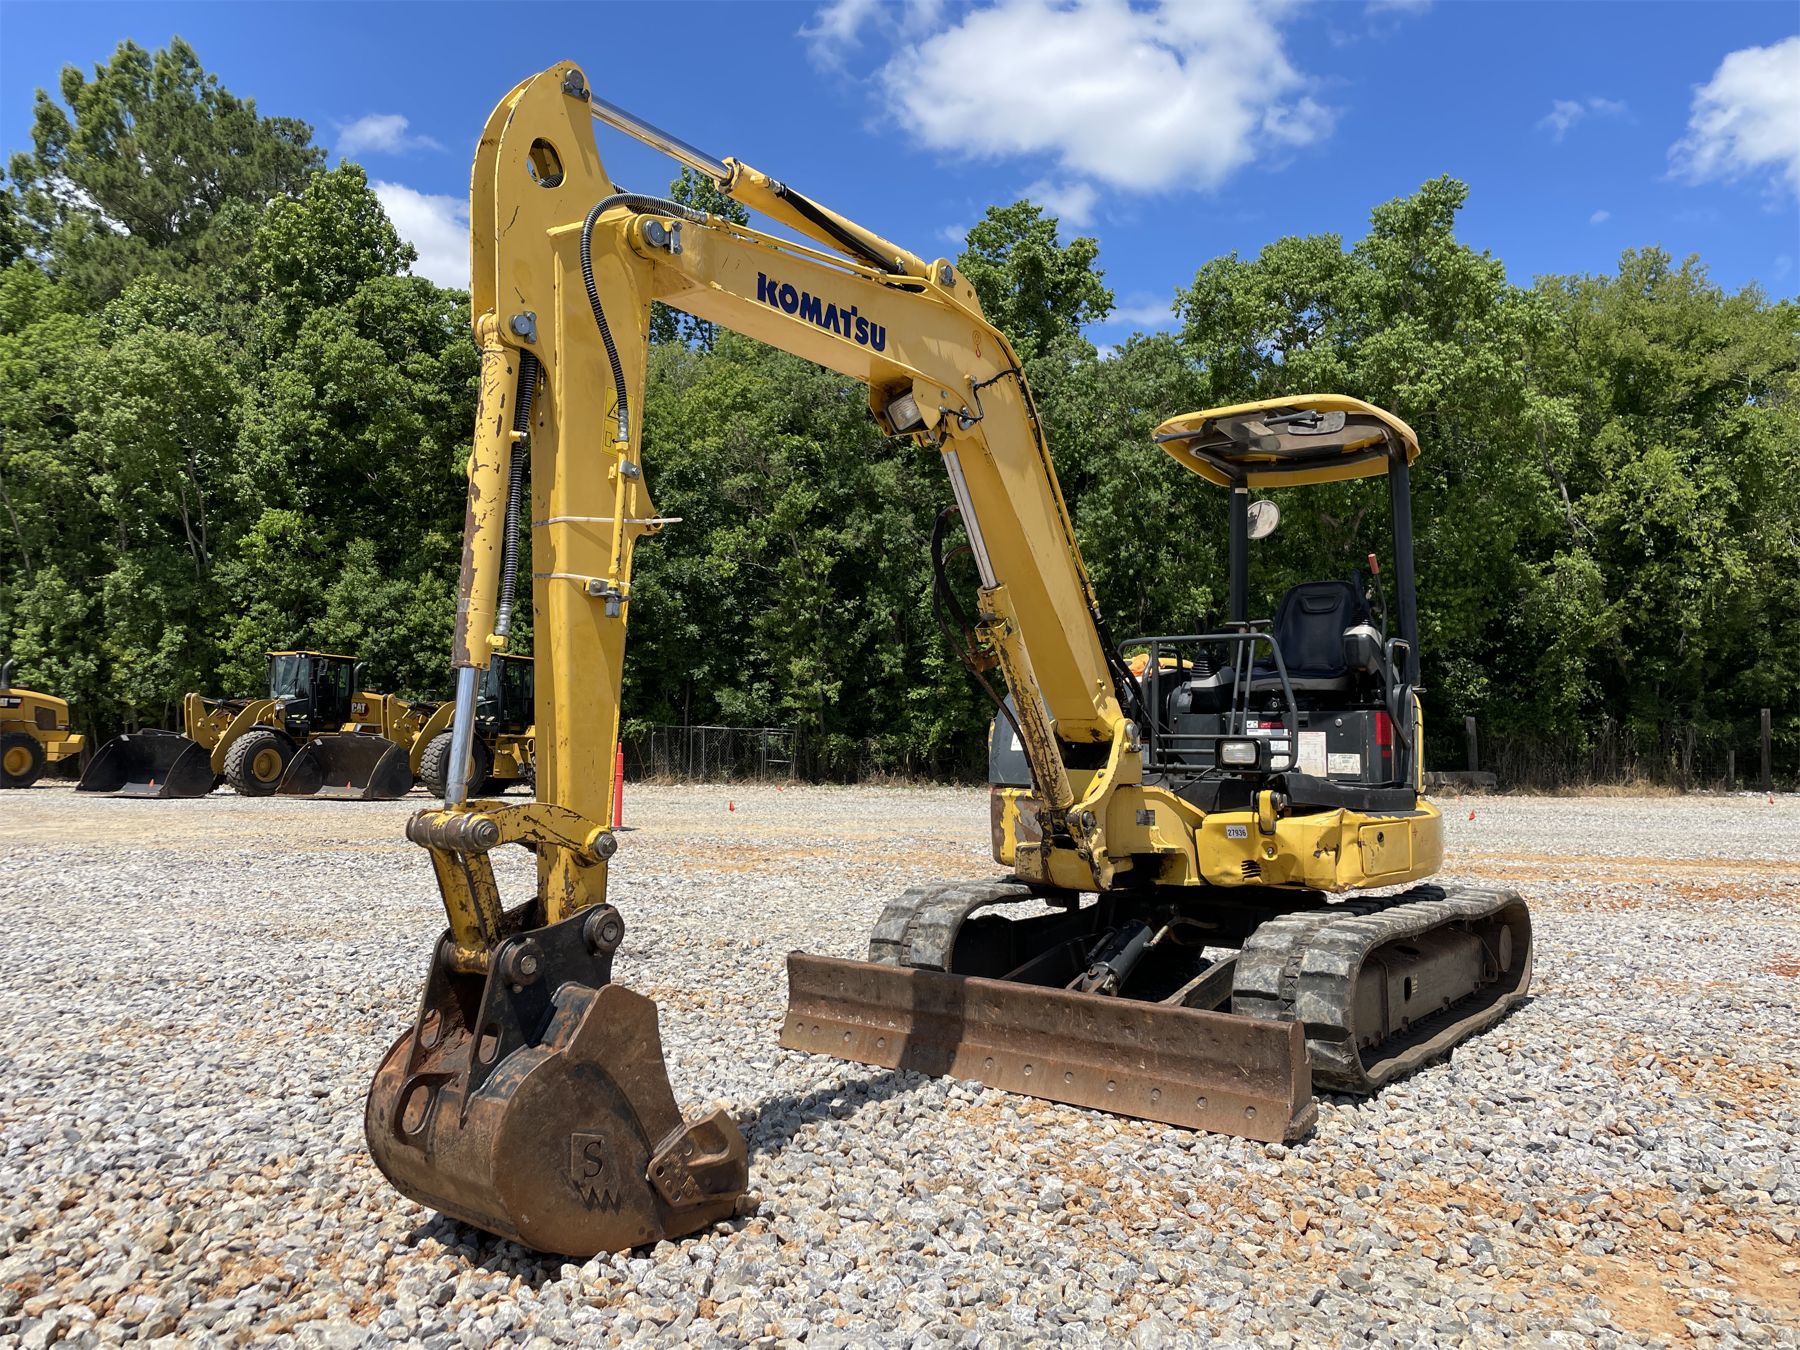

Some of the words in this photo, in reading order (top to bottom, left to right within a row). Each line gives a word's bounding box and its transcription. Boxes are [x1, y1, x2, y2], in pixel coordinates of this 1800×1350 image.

[757, 271, 886, 352] KOMATSU
[351, 702, 366, 714] CAT
[1227, 829, 1247, 837] 27936
[583, 1139, 603, 1179] S
